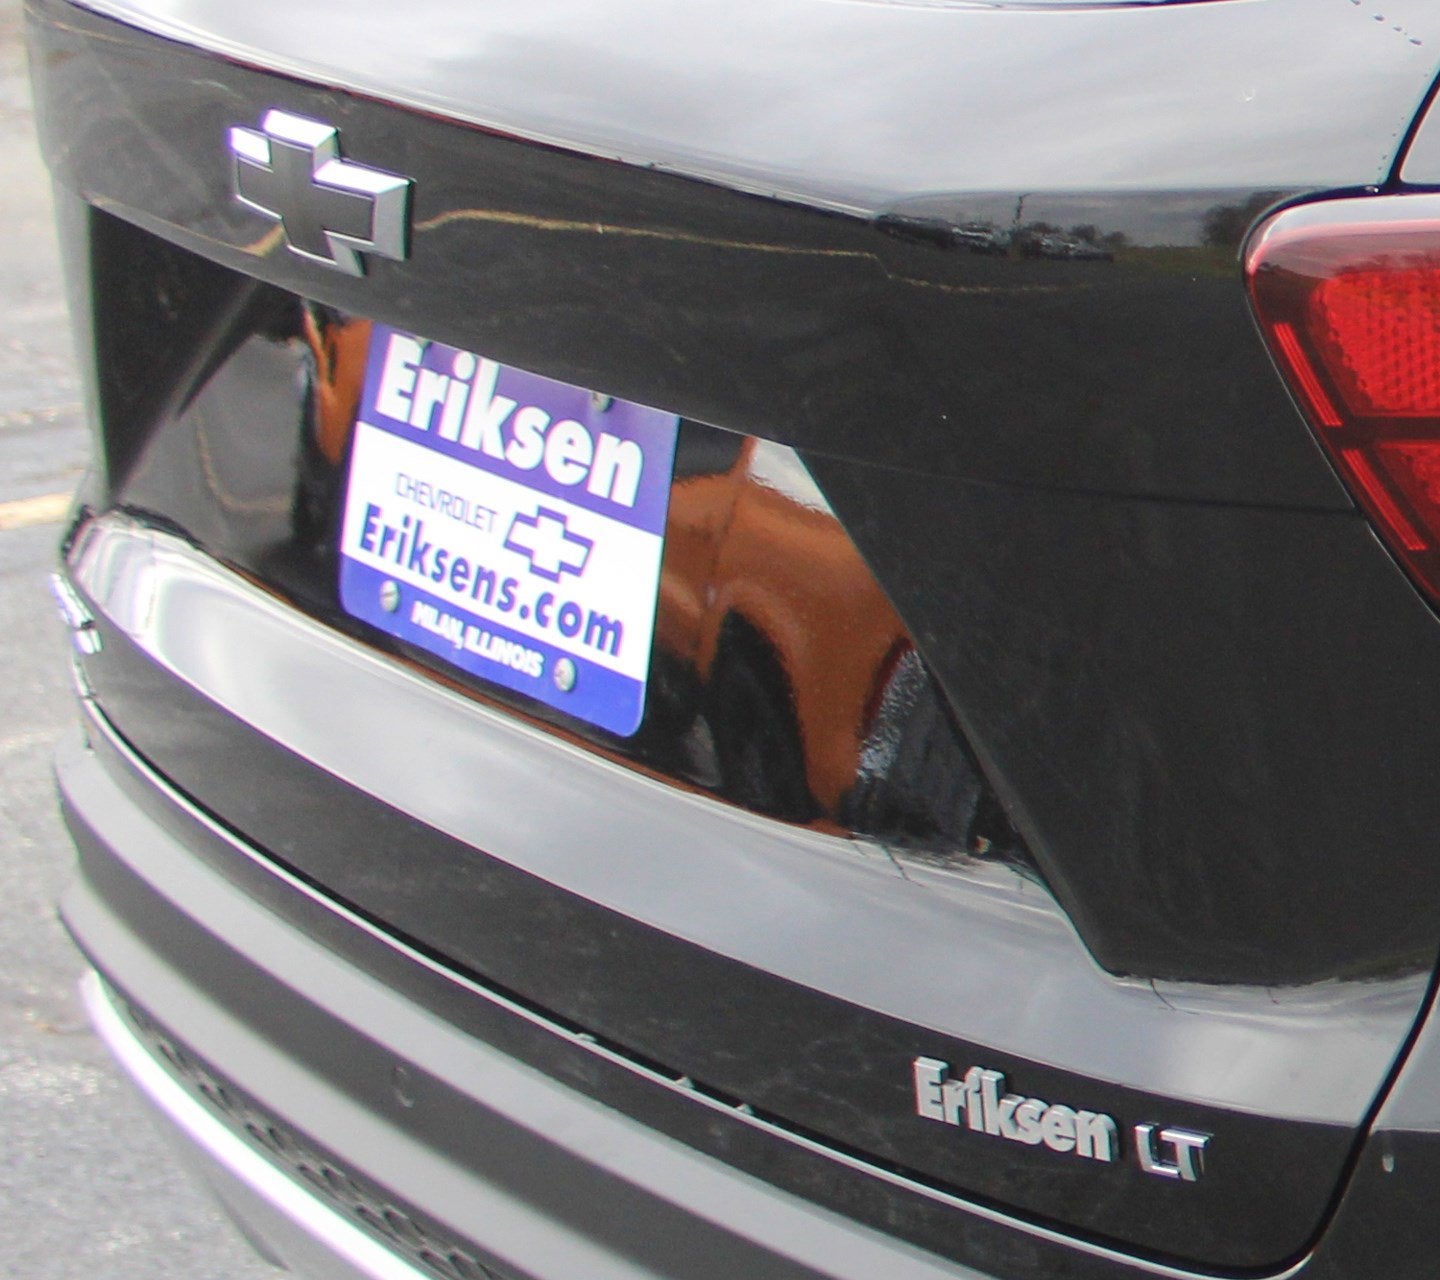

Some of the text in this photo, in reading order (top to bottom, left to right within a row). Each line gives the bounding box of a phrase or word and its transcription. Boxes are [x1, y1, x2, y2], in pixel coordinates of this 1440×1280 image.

[375, 332, 645, 508] Eriksen
[395, 471, 497, 535] CHEVROLET
[358, 501, 625, 659] Eriksens.com
[914, 1055, 1214, 1182] Eriksen LT
